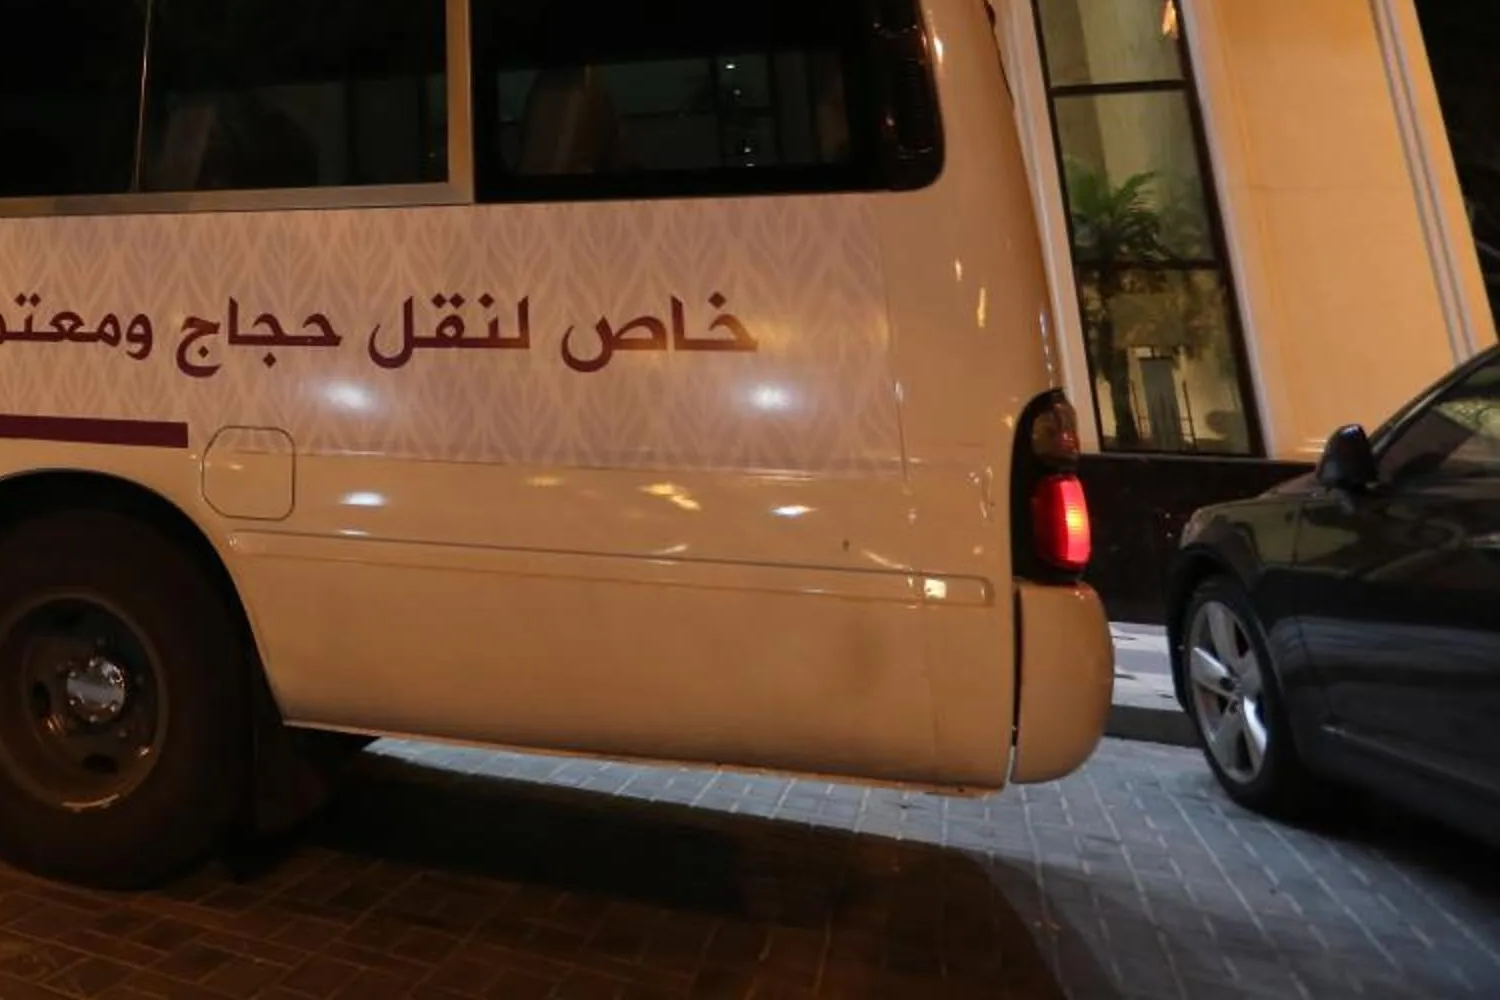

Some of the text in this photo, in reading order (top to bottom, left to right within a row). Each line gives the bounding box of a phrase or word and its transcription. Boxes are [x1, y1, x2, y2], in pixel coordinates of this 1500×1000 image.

[175, 296, 343, 378] حجاج
[367, 292, 531, 370] لنقل
[561, 292, 758, 373] خاص
